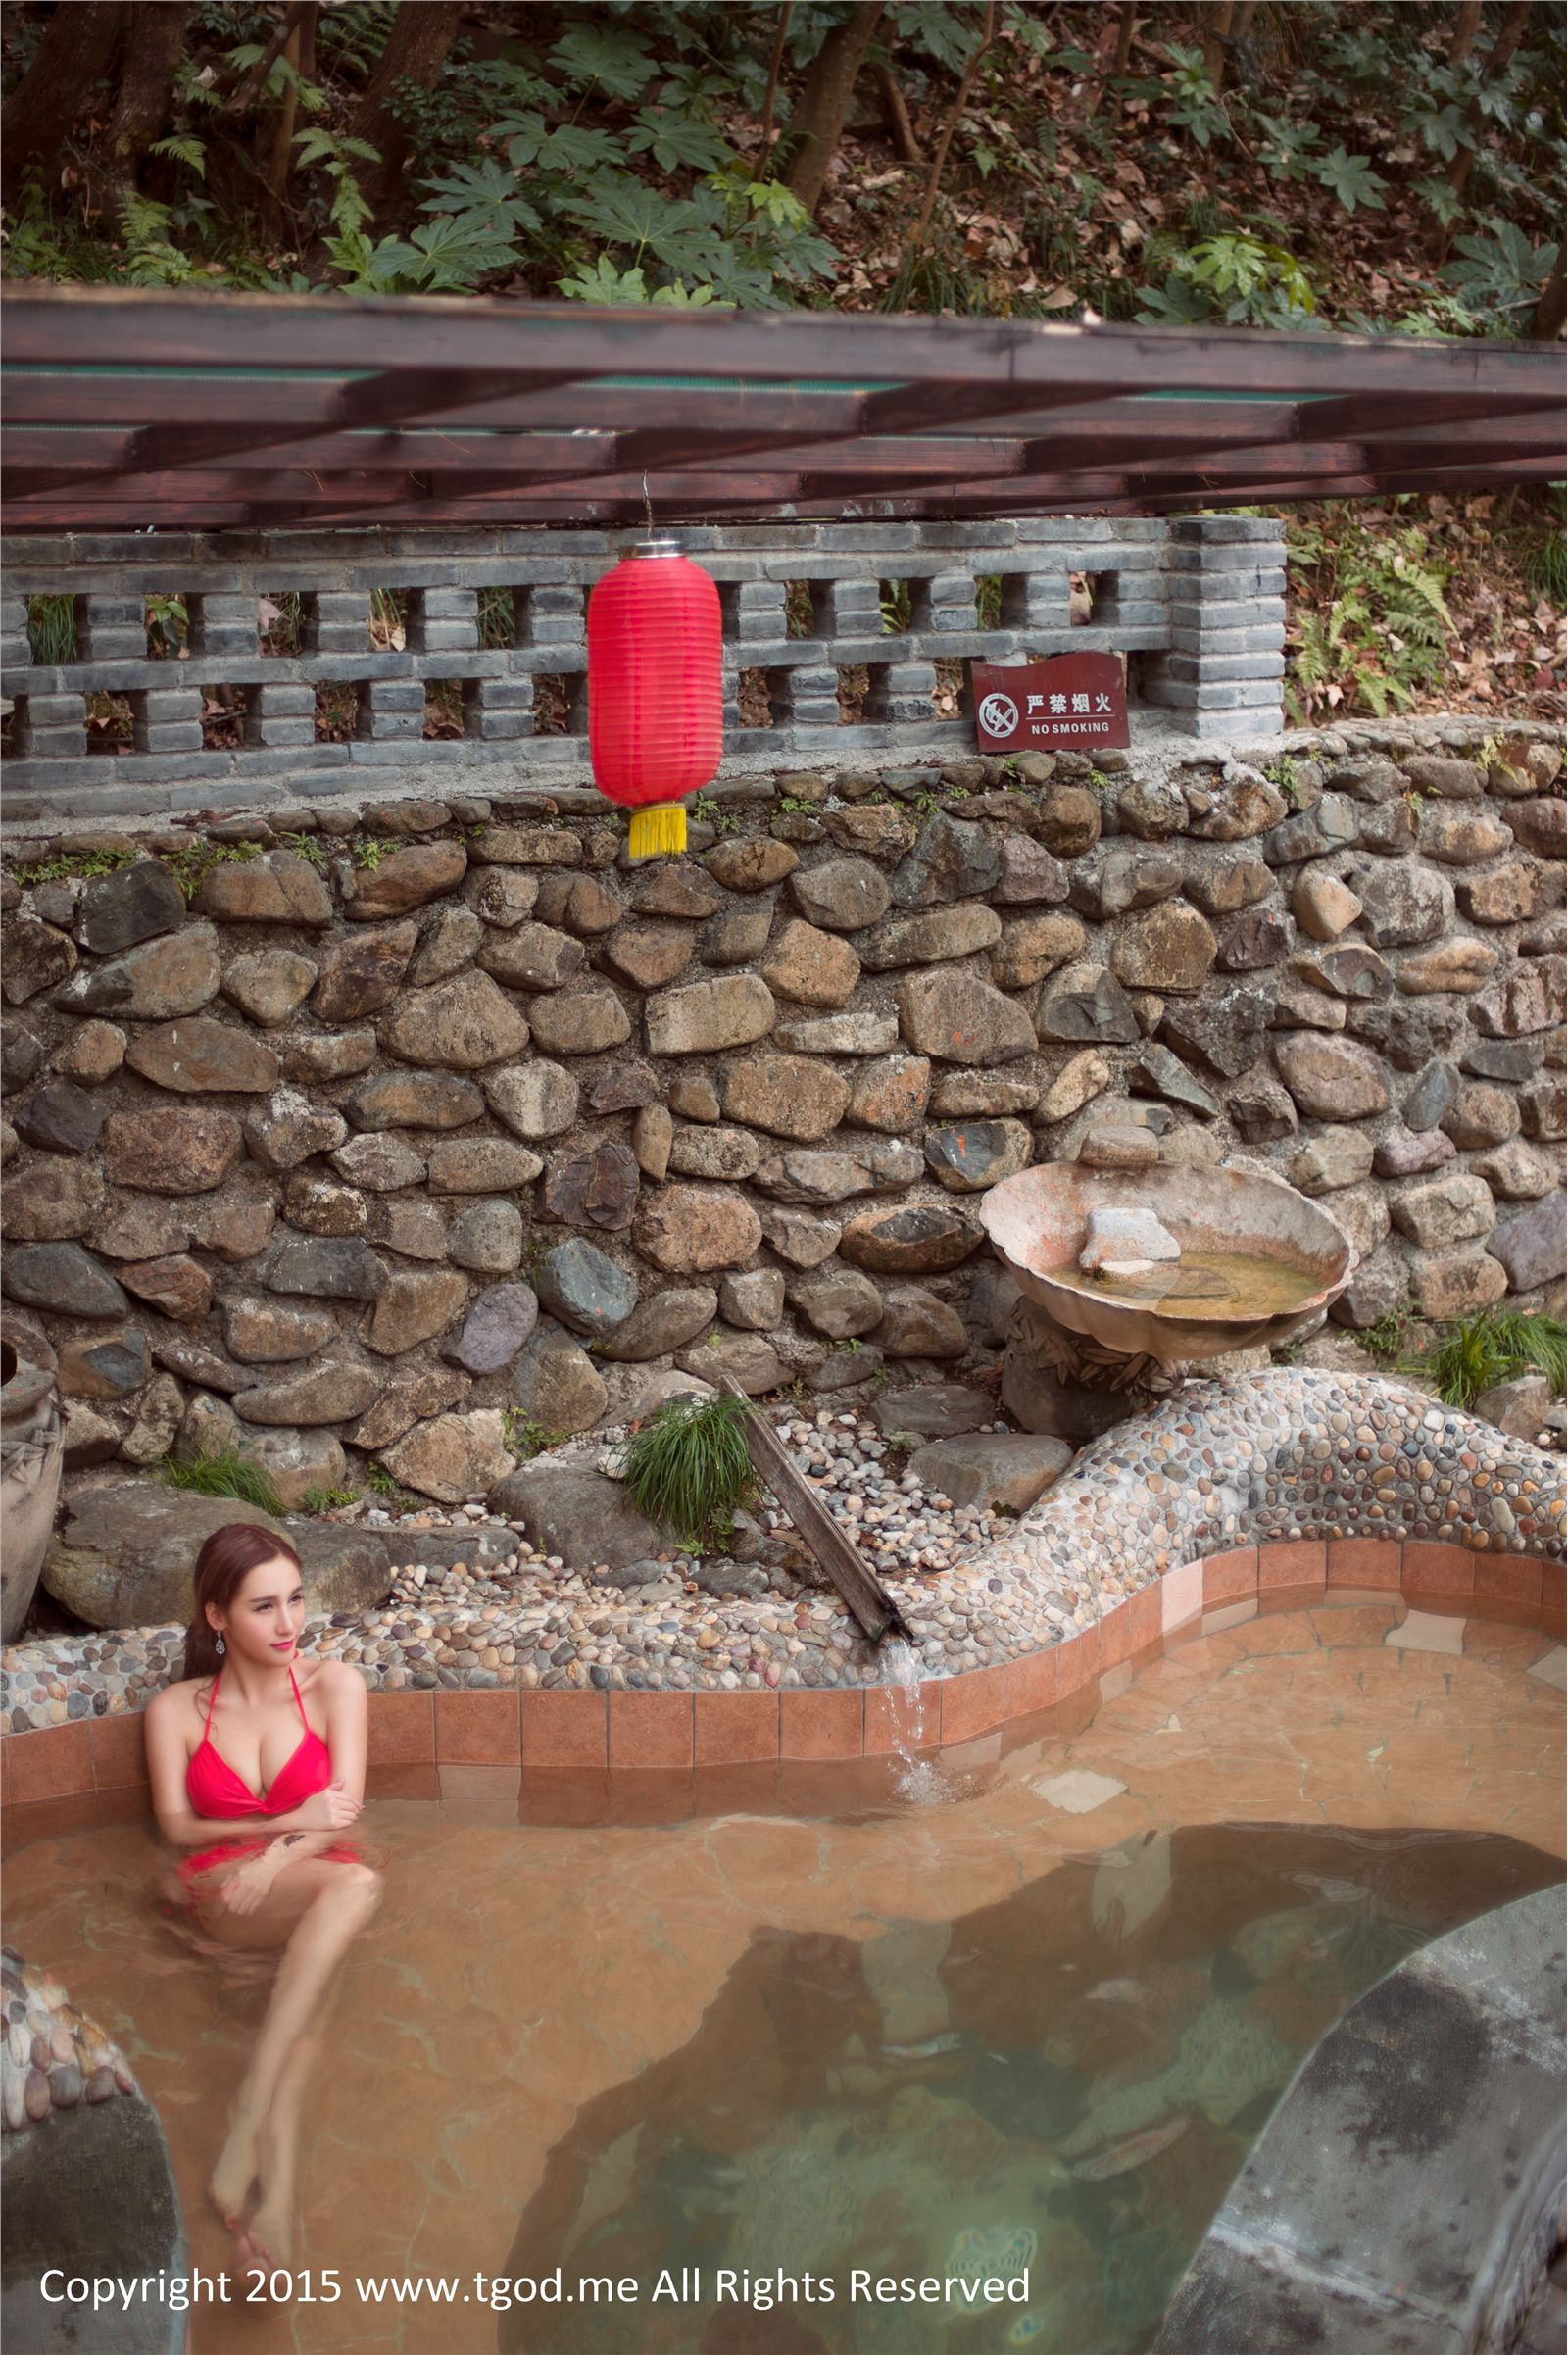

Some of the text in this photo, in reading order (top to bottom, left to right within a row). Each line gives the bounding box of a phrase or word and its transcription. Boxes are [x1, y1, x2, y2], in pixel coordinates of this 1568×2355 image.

[1026, 692, 1112, 714] 严禁烟火
[1031, 722, 1110, 735] NO SMOKING
